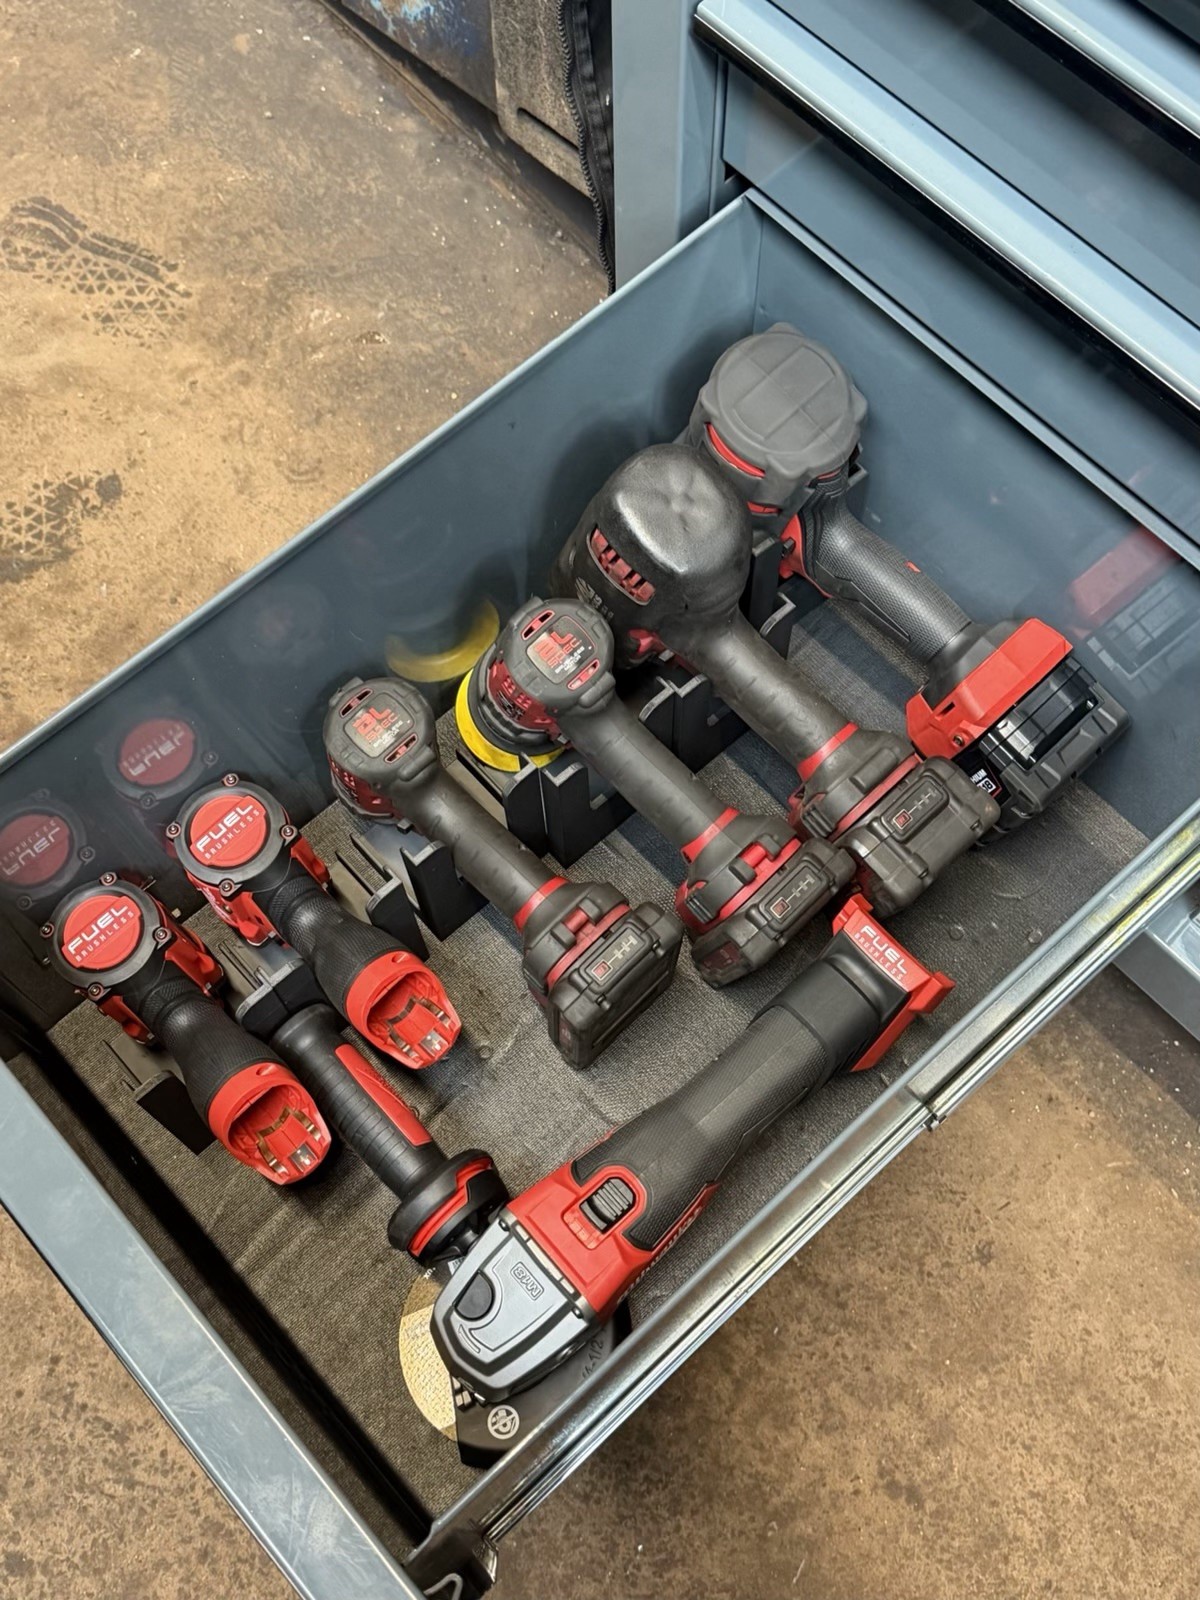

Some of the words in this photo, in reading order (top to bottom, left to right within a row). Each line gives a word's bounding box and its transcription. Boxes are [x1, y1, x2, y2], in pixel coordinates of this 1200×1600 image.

[196, 805, 254, 853] FUEL
[204, 809, 260, 860] BRUSHLESS
[68, 905, 128, 955] FUEL
[75, 911, 134, 962] BRUSHLESS
[861, 925, 907, 975] FUEL
[854, 932, 904, 980] BRUSHLESS
[512, 1266, 541, 1298] M18
